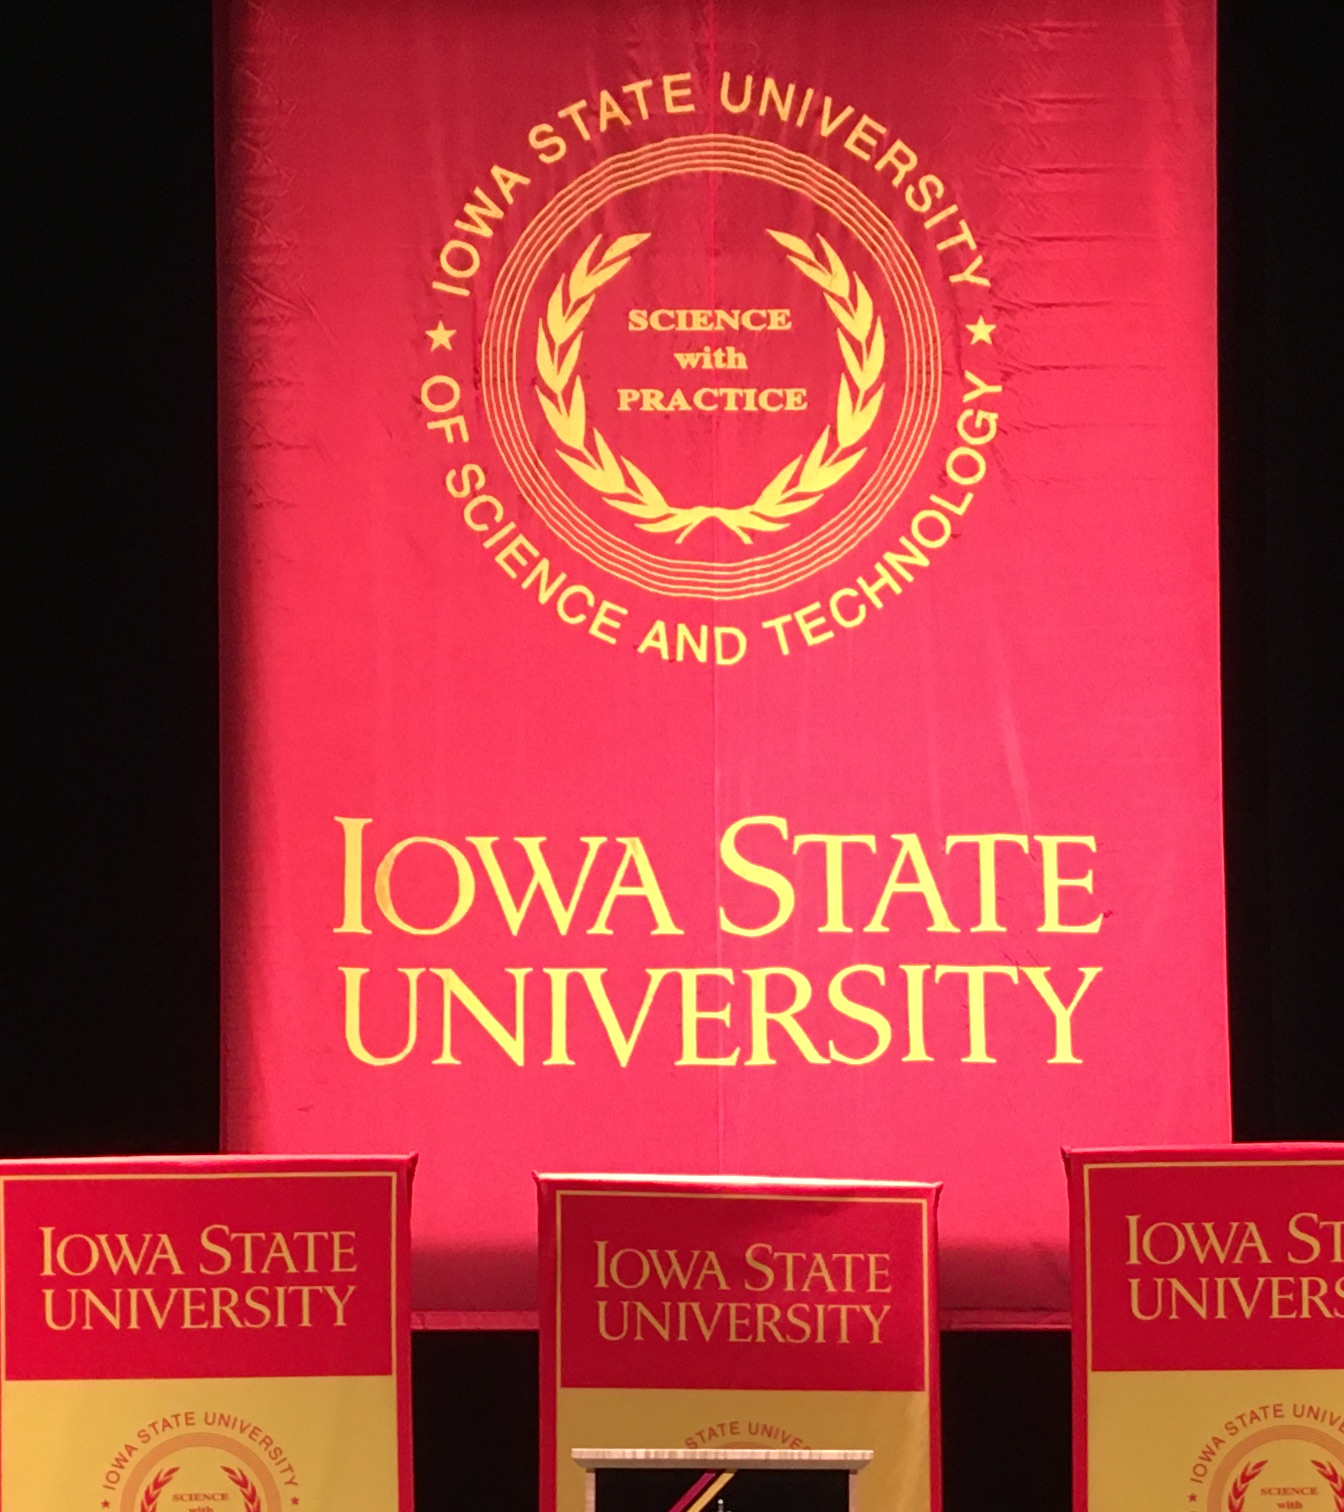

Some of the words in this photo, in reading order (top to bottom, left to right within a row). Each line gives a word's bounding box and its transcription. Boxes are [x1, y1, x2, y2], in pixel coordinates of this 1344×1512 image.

[432, 165, 530, 296] IOWA
[529, 72, 695, 163] STATE
[721, 72, 990, 286] UNIVERSITY
[629, 309, 792, 331] SCIENCE
[674, 346, 748, 369] with
[618, 388, 807, 412] PRACTICE
[421, 375, 469, 443] OF
[446, 464, 628, 644] SCIENCE
[638, 620, 747, 665] AND
[762, 371, 1002, 655] TECHNOLOGY
[334, 817, 684, 936] IOWA
[719, 815, 1103, 937] STATE
[339, 964, 1103, 1067] UNIVERSITY
[41, 1227, 183, 1275] IOWA
[200, 1225, 356, 1275] STATE
[1127, 1215, 1271, 1264] IOWA
[596, 1241, 730, 1290] IOWA
[745, 1243, 891, 1292] STATE
[43, 1286, 355, 1330] UNIVERSITY
[598, 1301, 891, 1343] UNIVERSITY
[102, 1443, 139, 1491] IOWA
[136, 1411, 196, 1444] STATE
[203, 1411, 299, 1487] UNIVERSITY
[1189, 1436, 1226, 1484] IOWA
[1224, 1403, 1285, 1437] STATE
[171, 1492, 229, 1501] SCIENCE
[1259, 1487, 1319, 1496] SCIENCE
[1276, 1499, 1303, 1510] with
